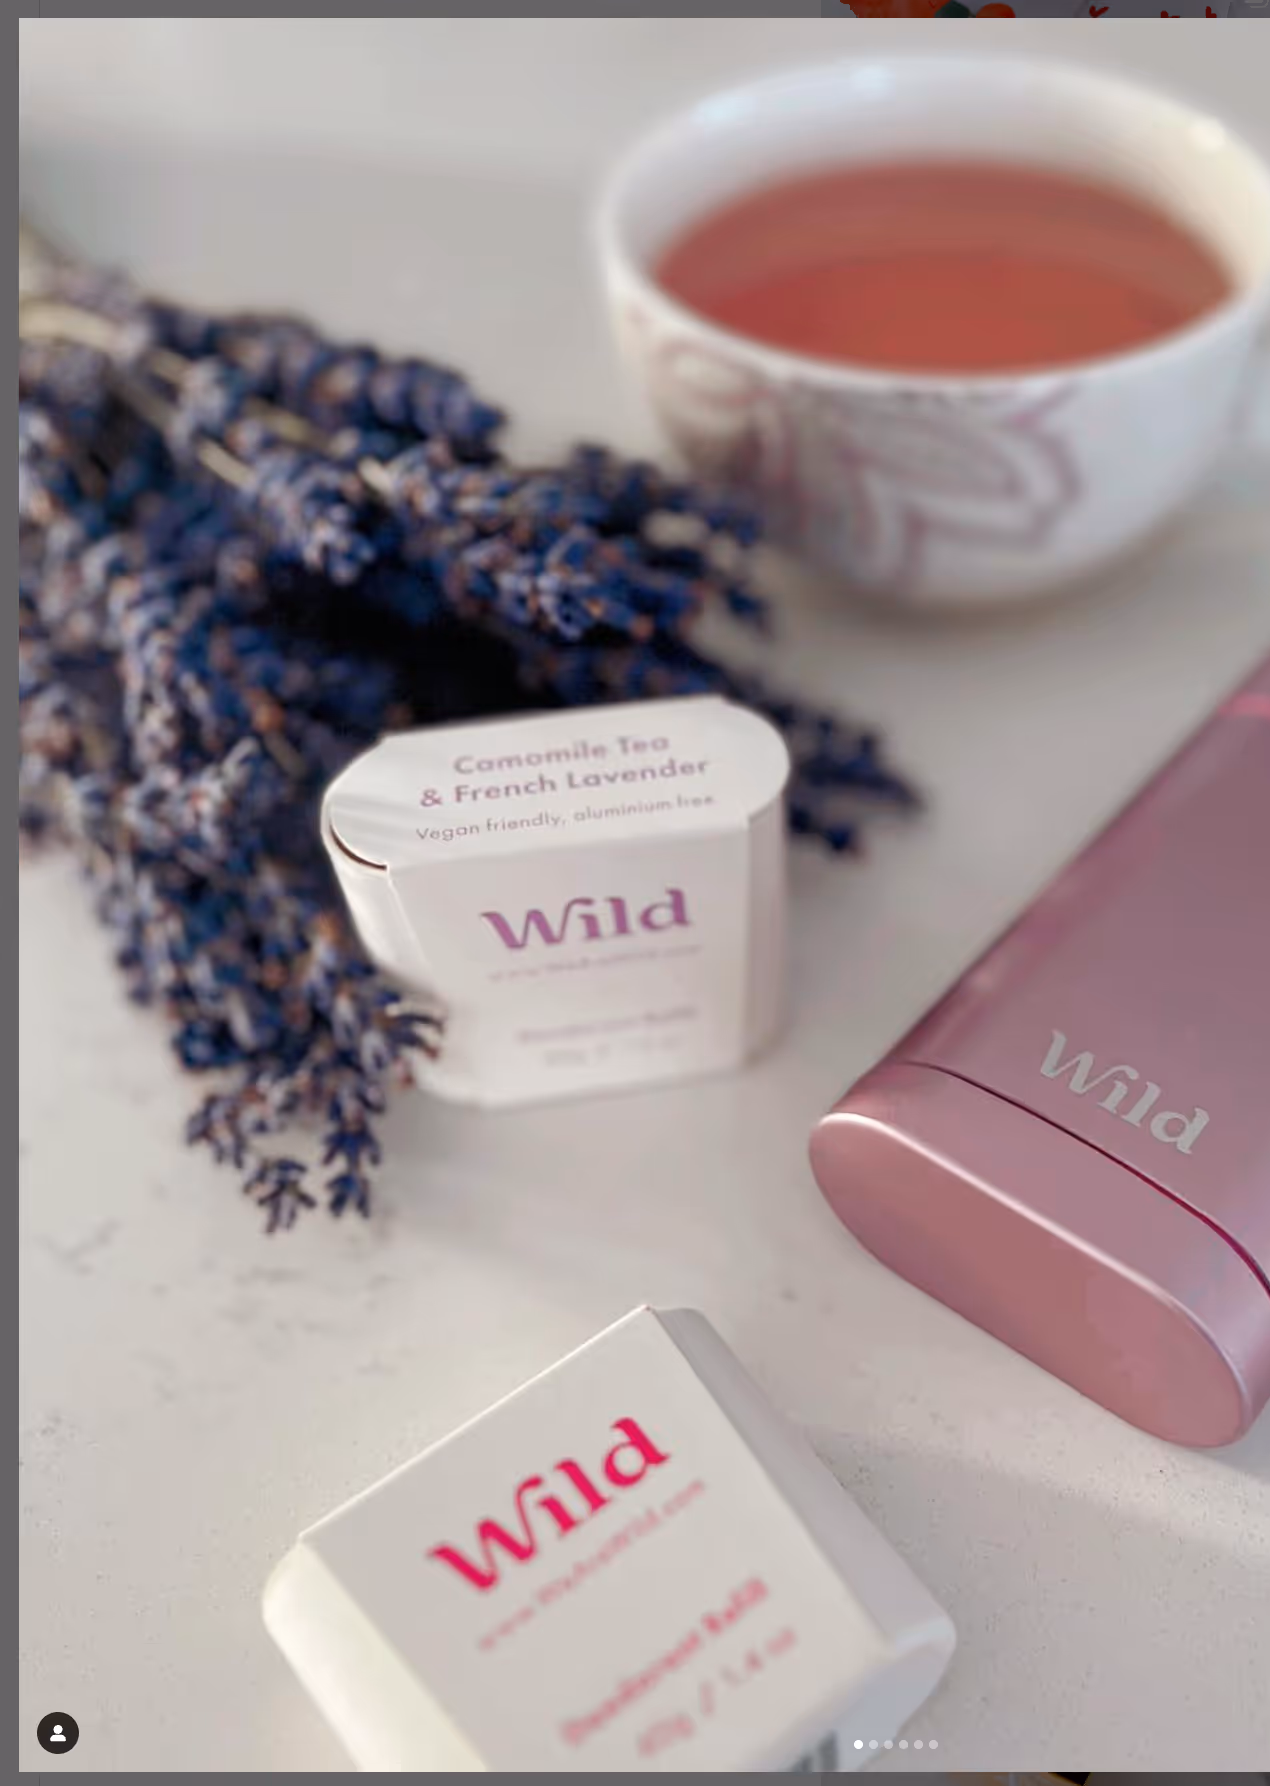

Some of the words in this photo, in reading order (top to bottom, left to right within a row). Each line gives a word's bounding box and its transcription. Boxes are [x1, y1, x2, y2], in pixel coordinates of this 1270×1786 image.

[419, 787, 443, 807] &
[453, 773, 557, 803] French
[566, 757, 709, 789] Lavender
[453, 739, 608, 776] Camomile
[616, 735, 670, 756] Tea
[415, 823, 480, 841] Vegan
[486, 811, 567, 833] friendly,
[573, 799, 673, 822] aluminium
[676, 793, 715, 809] free
[479, 887, 693, 951] Wild
[1040, 1028, 1210, 1155] Wild
[425, 1415, 671, 1594] Wild
